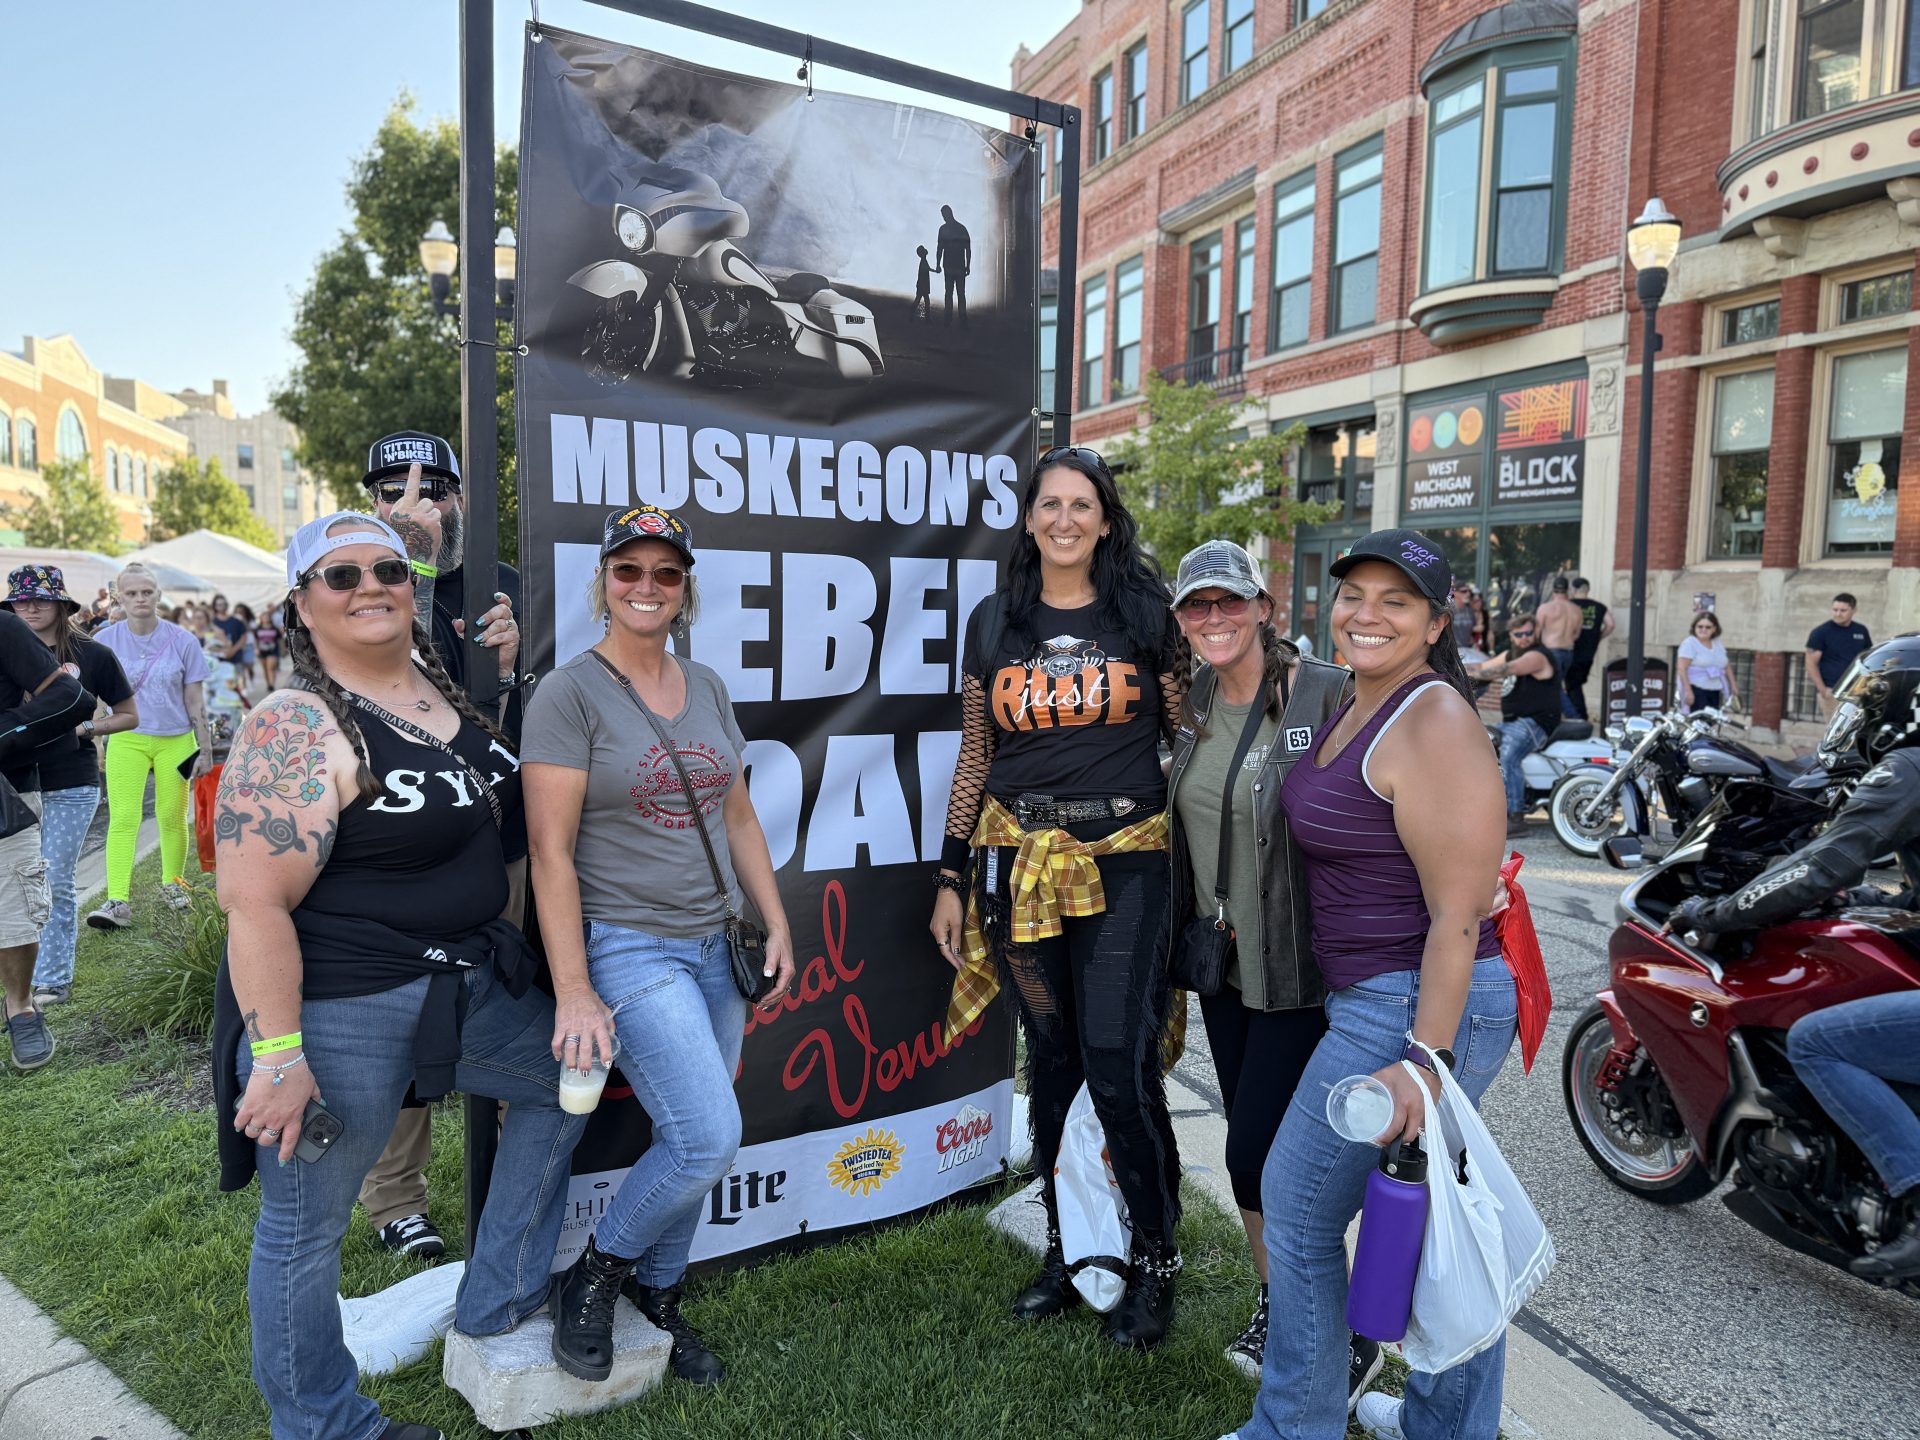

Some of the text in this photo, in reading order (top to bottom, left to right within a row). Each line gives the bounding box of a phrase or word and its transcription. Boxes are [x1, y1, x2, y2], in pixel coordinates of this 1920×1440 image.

[383, 440, 432, 454] TITTIES
[550, 413, 1018, 530] MUSKEGON'S
[1427, 460, 1459, 477] WEST
[1499, 454, 1578, 489] BLOCK
[1414, 475, 1472, 495] MICHIGAN
[1507, 490, 1520, 499] WEST
[1520, 488, 1545, 498] MICHIGAN
[1546, 486, 1576, 496] SYMPHONY
[1410, 491, 1474, 511] SYMPHONY
[618, 509, 640, 526] FREE
[657, 508, 670, 519] BE
[669, 518, 683, 533] ME
[1401, 540, 1439, 563] FUCK
[1401, 551, 1429, 568] OFF
[991, 662, 1141, 732] RIDE
[1013, 673, 1110, 723] just
[357, 697, 453, 756] HARLEY-DAVIDSON
[688, 740, 725, 761] 1901
[1289, 730, 1310, 748] 69
[936, 1112, 994, 1154] Coors
[841, 1147, 892, 1170] TWISTED TEA
[938, 1135, 989, 1174] LIGHT
[849, 1164, 863, 1174] Hard
[856, 1170, 877, 1179] ORIGINAL
[706, 1170, 787, 1225] Lite
